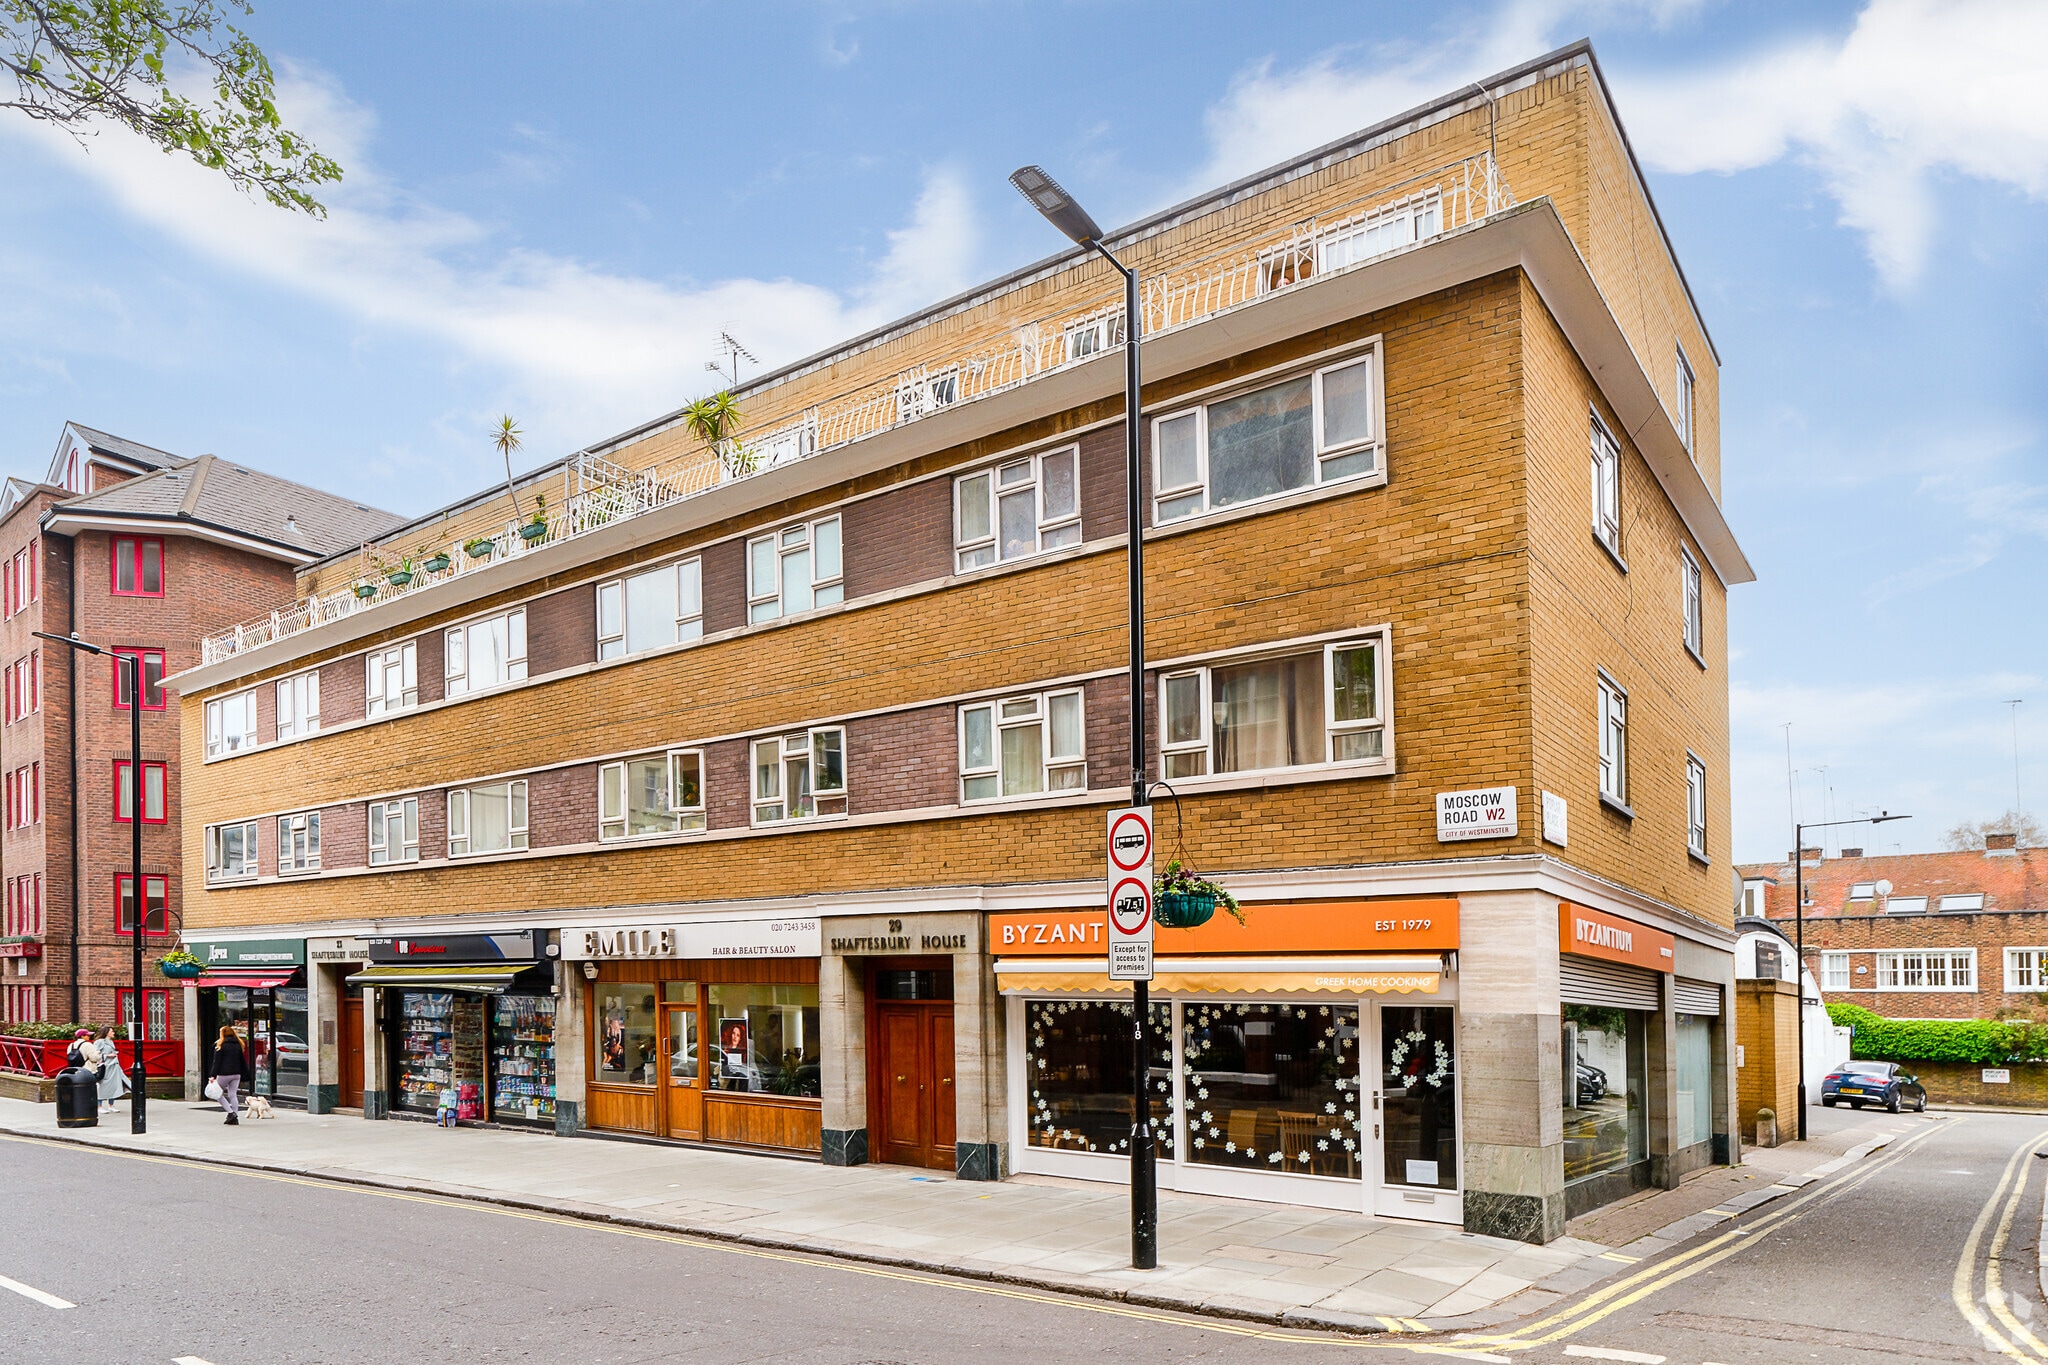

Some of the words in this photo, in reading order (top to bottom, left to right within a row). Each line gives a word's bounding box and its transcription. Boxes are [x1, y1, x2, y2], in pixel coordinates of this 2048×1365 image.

[1444, 792, 1502, 810] MOSCOW
[1444, 810, 1478, 825] ROAD
[1485, 807, 1505, 821] W2
[1467, 826, 1509, 836] WESTMINSTER
[1125, 898, 1143, 910] 7.5T
[771, 923, 783, 932] 020
[784, 923, 799, 931] 7243
[800, 922, 816, 931] 3458
[888, 918, 903, 933] 29
[1375, 920, 1397, 931] EST
[1401, 919, 1432, 930] 1979
[1002, 923, 1104, 944] BYZANT
[1576, 917, 1633, 953] BYZANTIUM
[580, 928, 677, 957] EMILE
[830, 936, 911, 951] SHAFTESBURY
[921, 934, 967, 949] HOUSE
[348, 950, 369, 959] HOUSE
[712, 947, 731, 955] HAIR
[731, 947, 738, 955] &
[738, 946, 769, 955] BEAUTY
[769, 945, 796, 954] SALON
[1114, 945, 1136, 954] Except
[1137, 945, 1147, 953] for
[1116, 963, 1145, 971] premises
[1315, 977, 1346, 986] GREEK
[1347, 977, 1379, 987] HOME
[1380, 977, 1431, 987] COOKING
